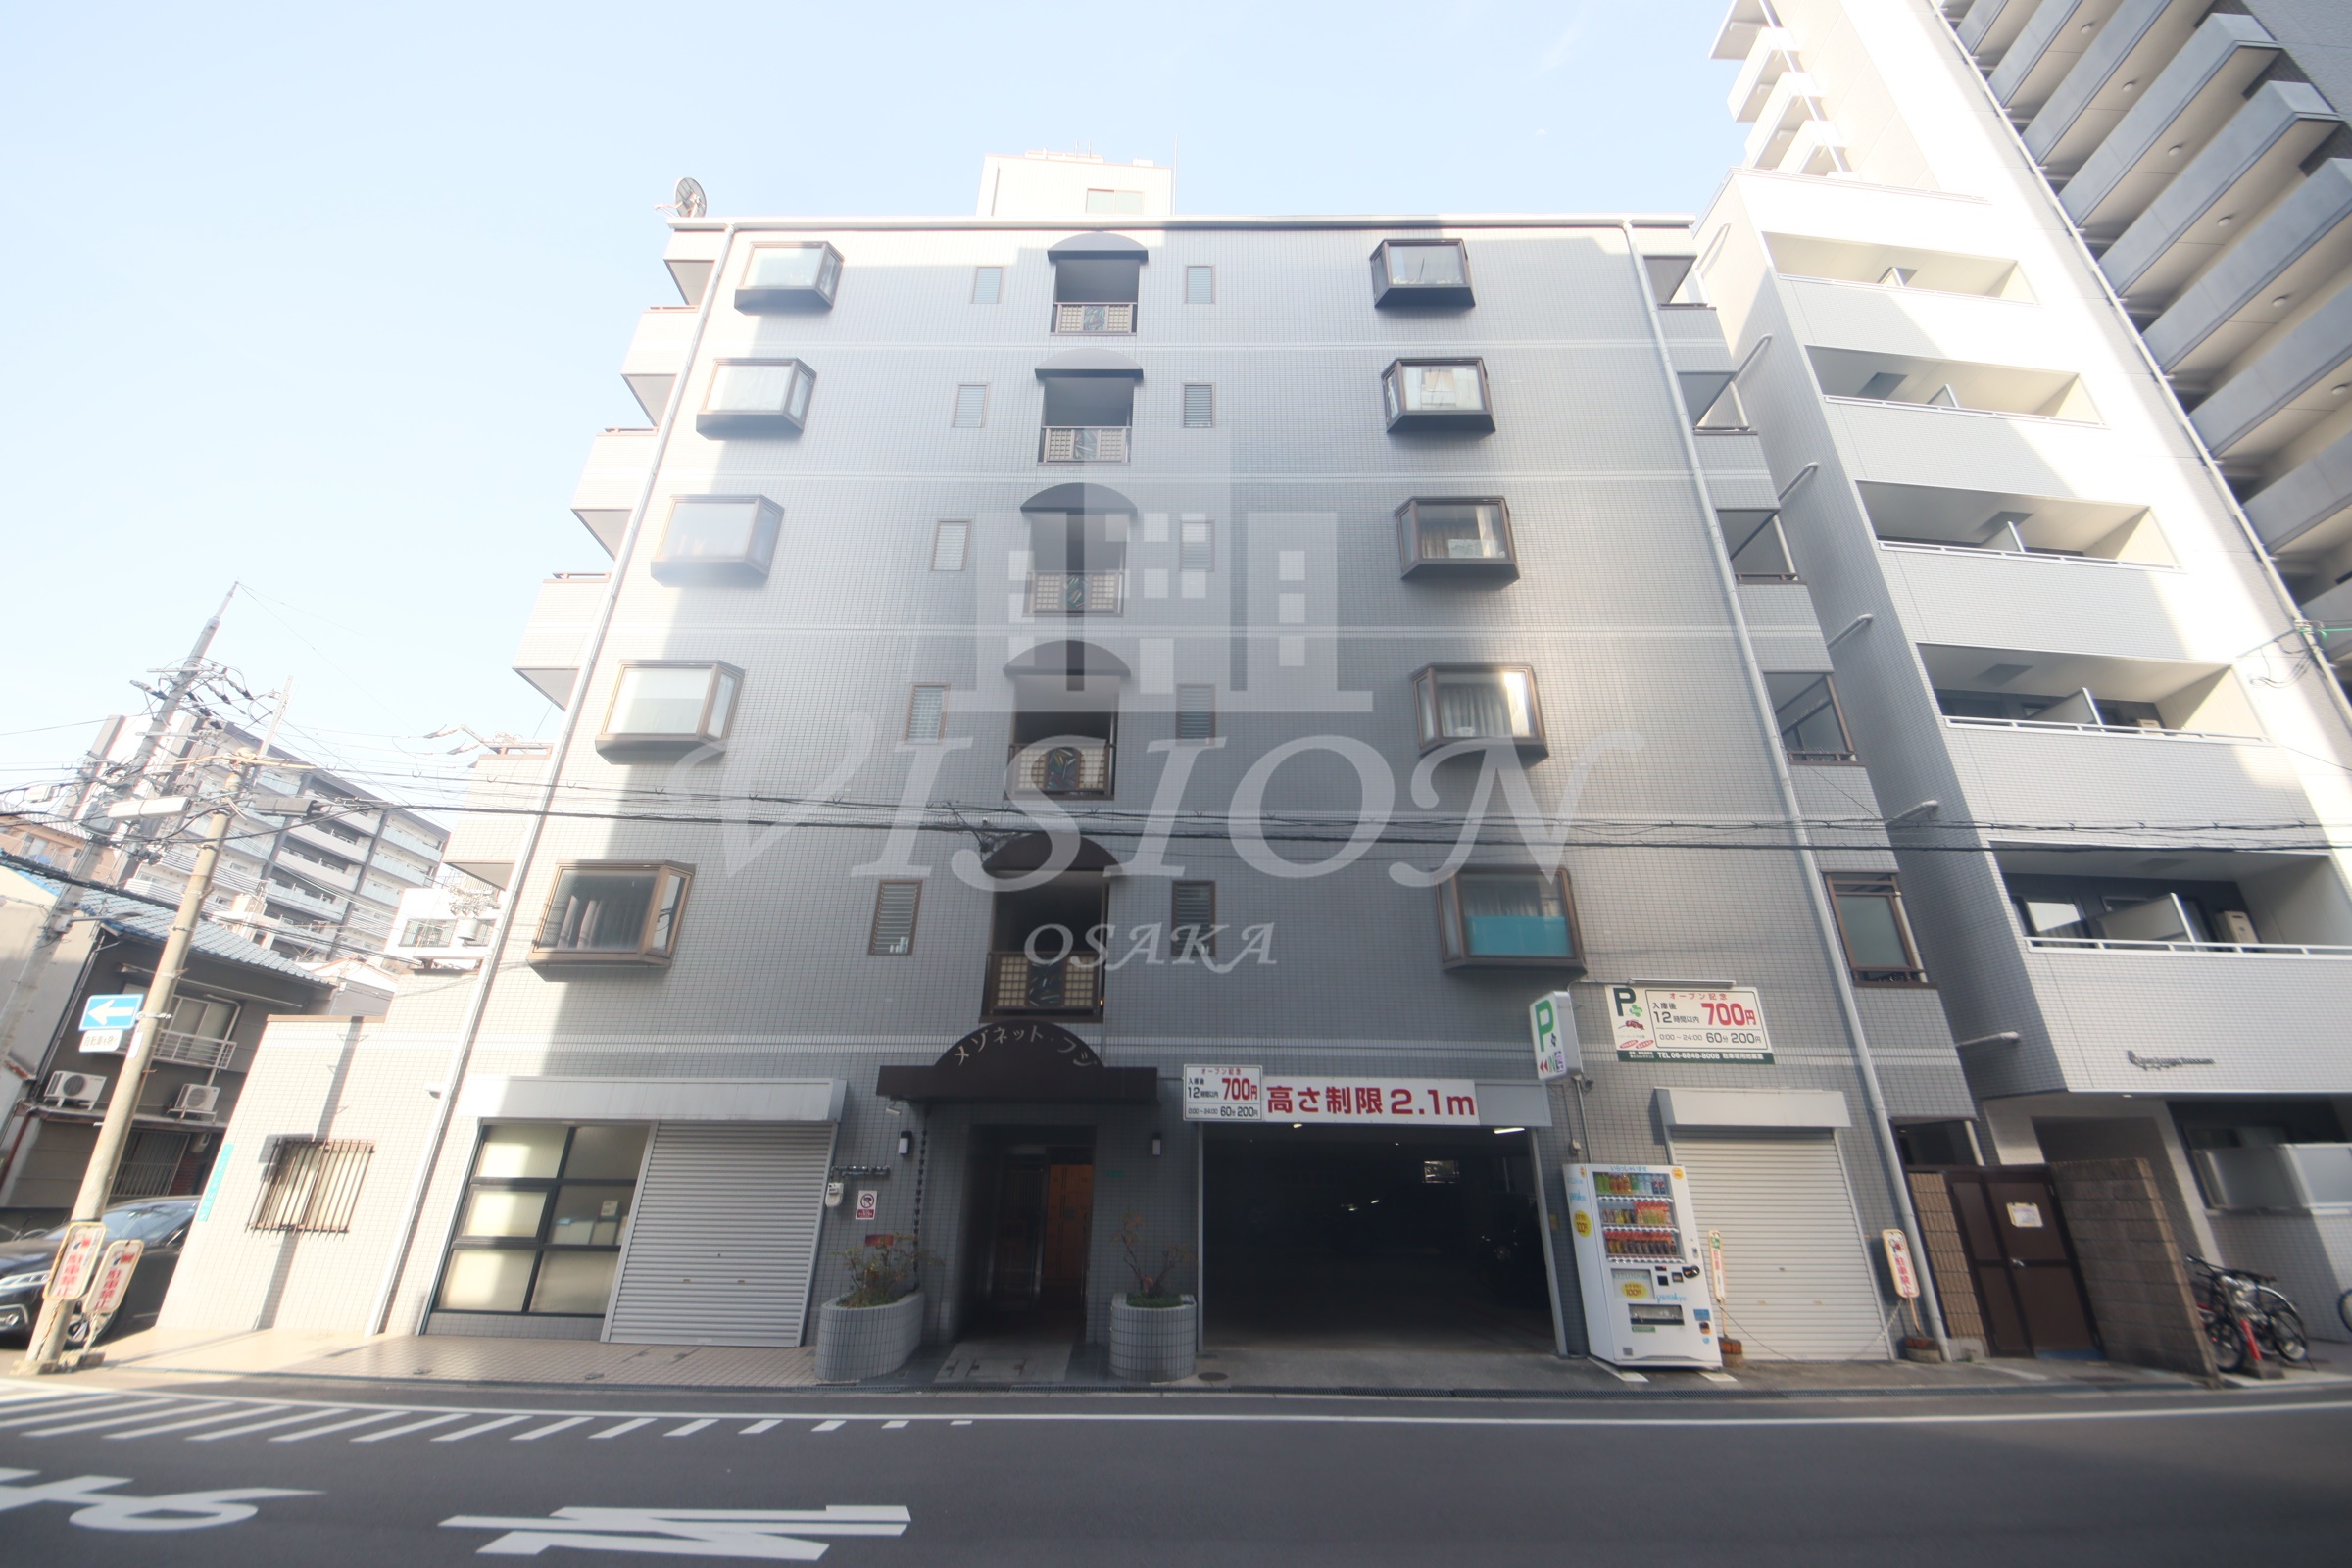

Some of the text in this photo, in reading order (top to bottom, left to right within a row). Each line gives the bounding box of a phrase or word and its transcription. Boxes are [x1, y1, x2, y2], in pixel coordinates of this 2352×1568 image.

[1613, 988, 1637, 1017] P
[1701, 1003, 1756, 1026] 700円
[1535, 1000, 1554, 1053] P
[1731, 1033, 1762, 1044] 200円
[1222, 1078, 1257, 1100] 700円
